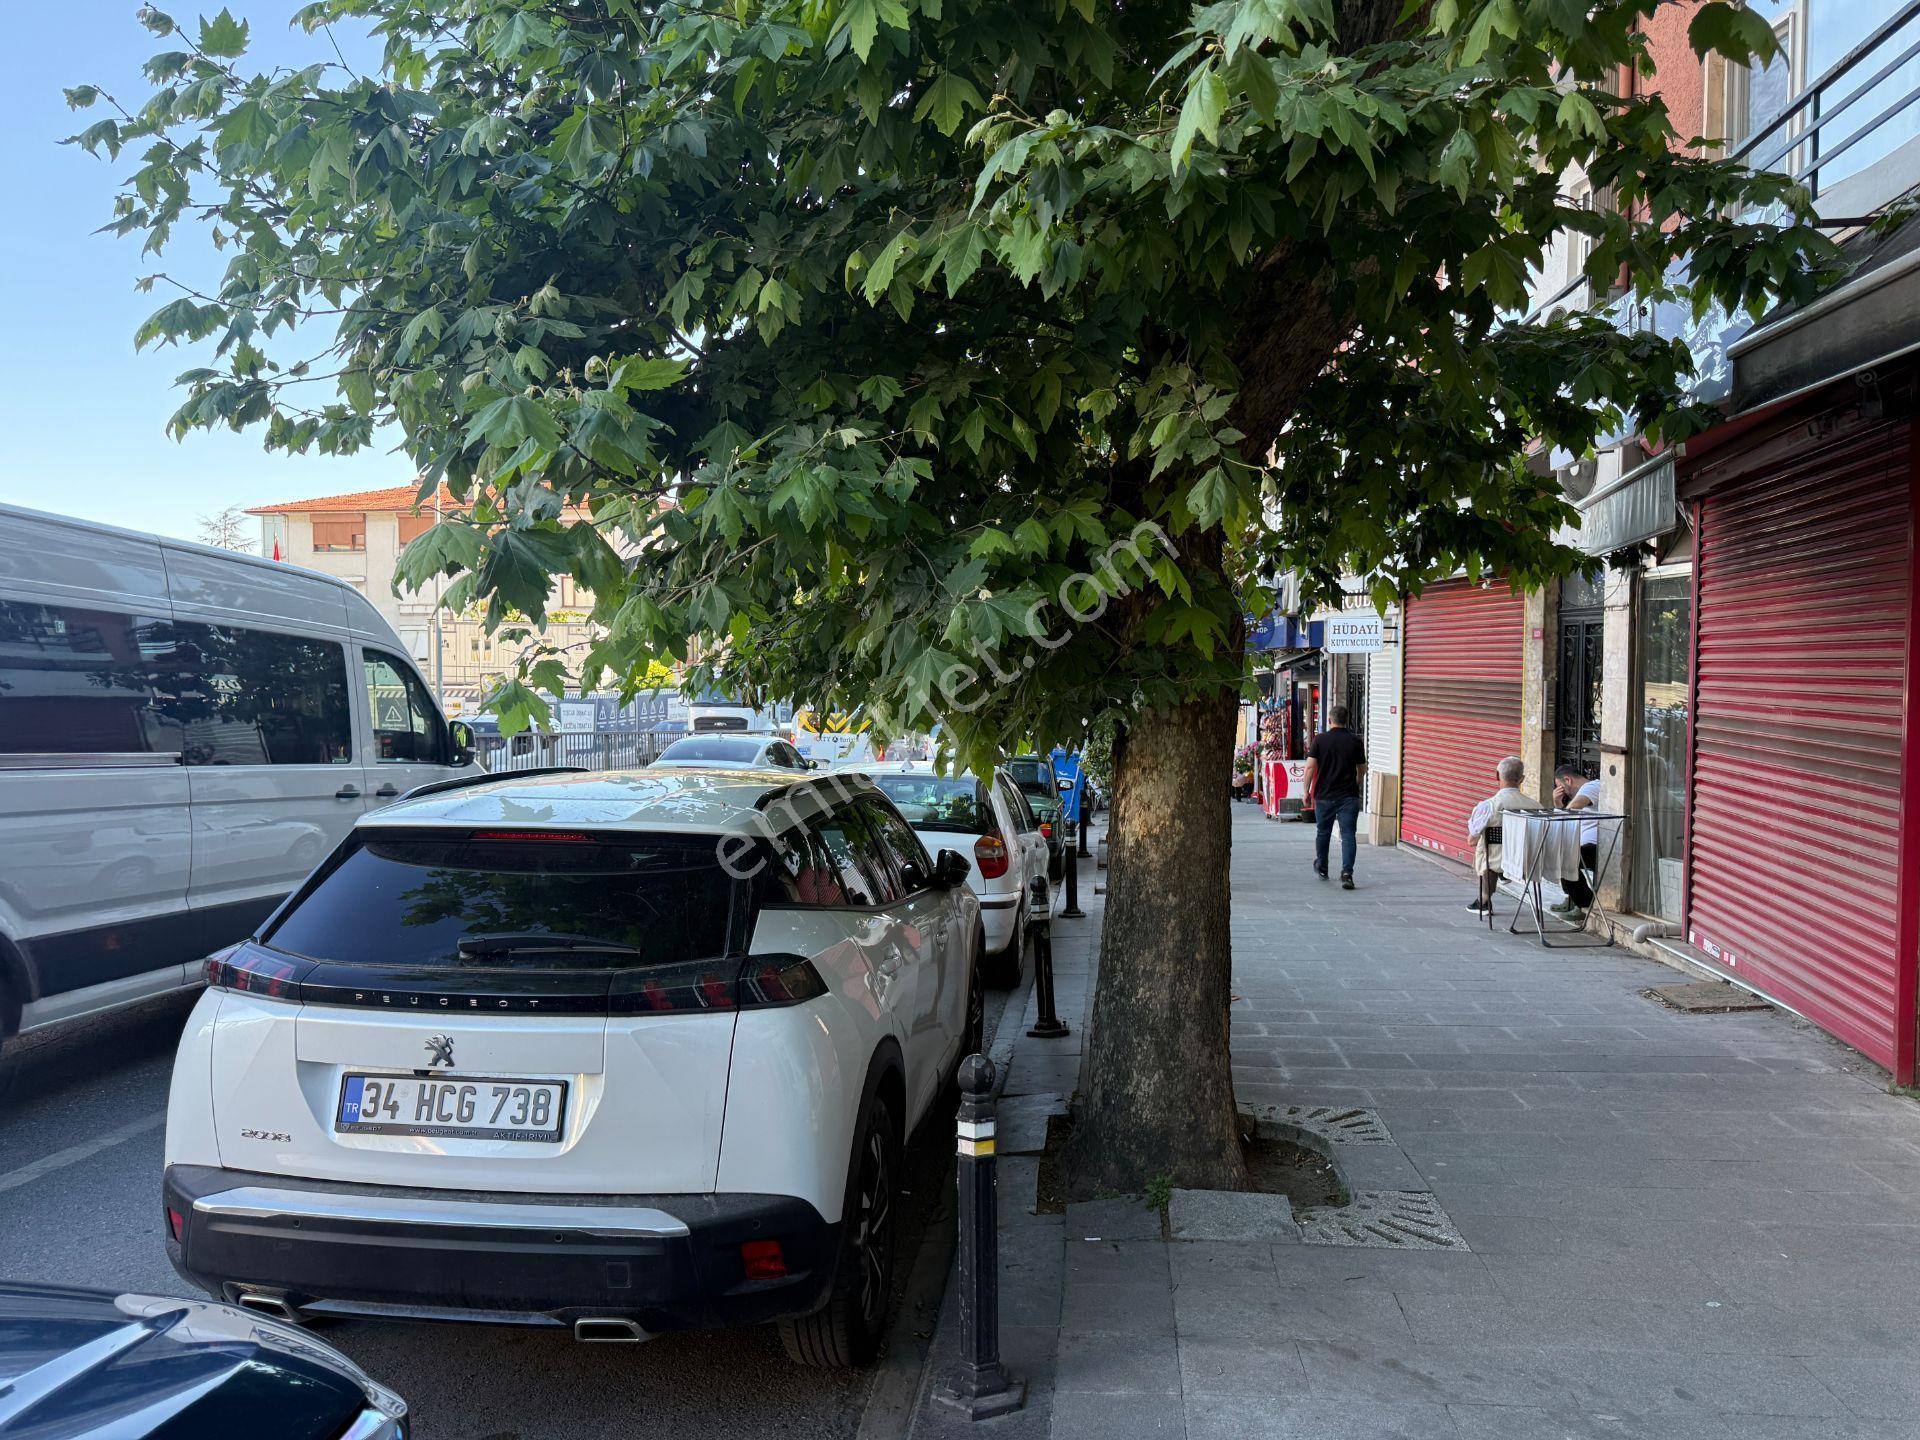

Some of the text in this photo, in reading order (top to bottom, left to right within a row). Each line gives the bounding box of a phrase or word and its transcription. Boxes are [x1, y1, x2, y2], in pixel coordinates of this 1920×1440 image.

[1332, 620, 1379, 635] HÜDAYİ
[1330, 638, 1380, 647] KUYUMCULUK
[355, 993, 539, 1008] PEUGEOT
[345, 1102, 359, 1114] TR
[362, 1082, 552, 1126] 34 HCG 738
